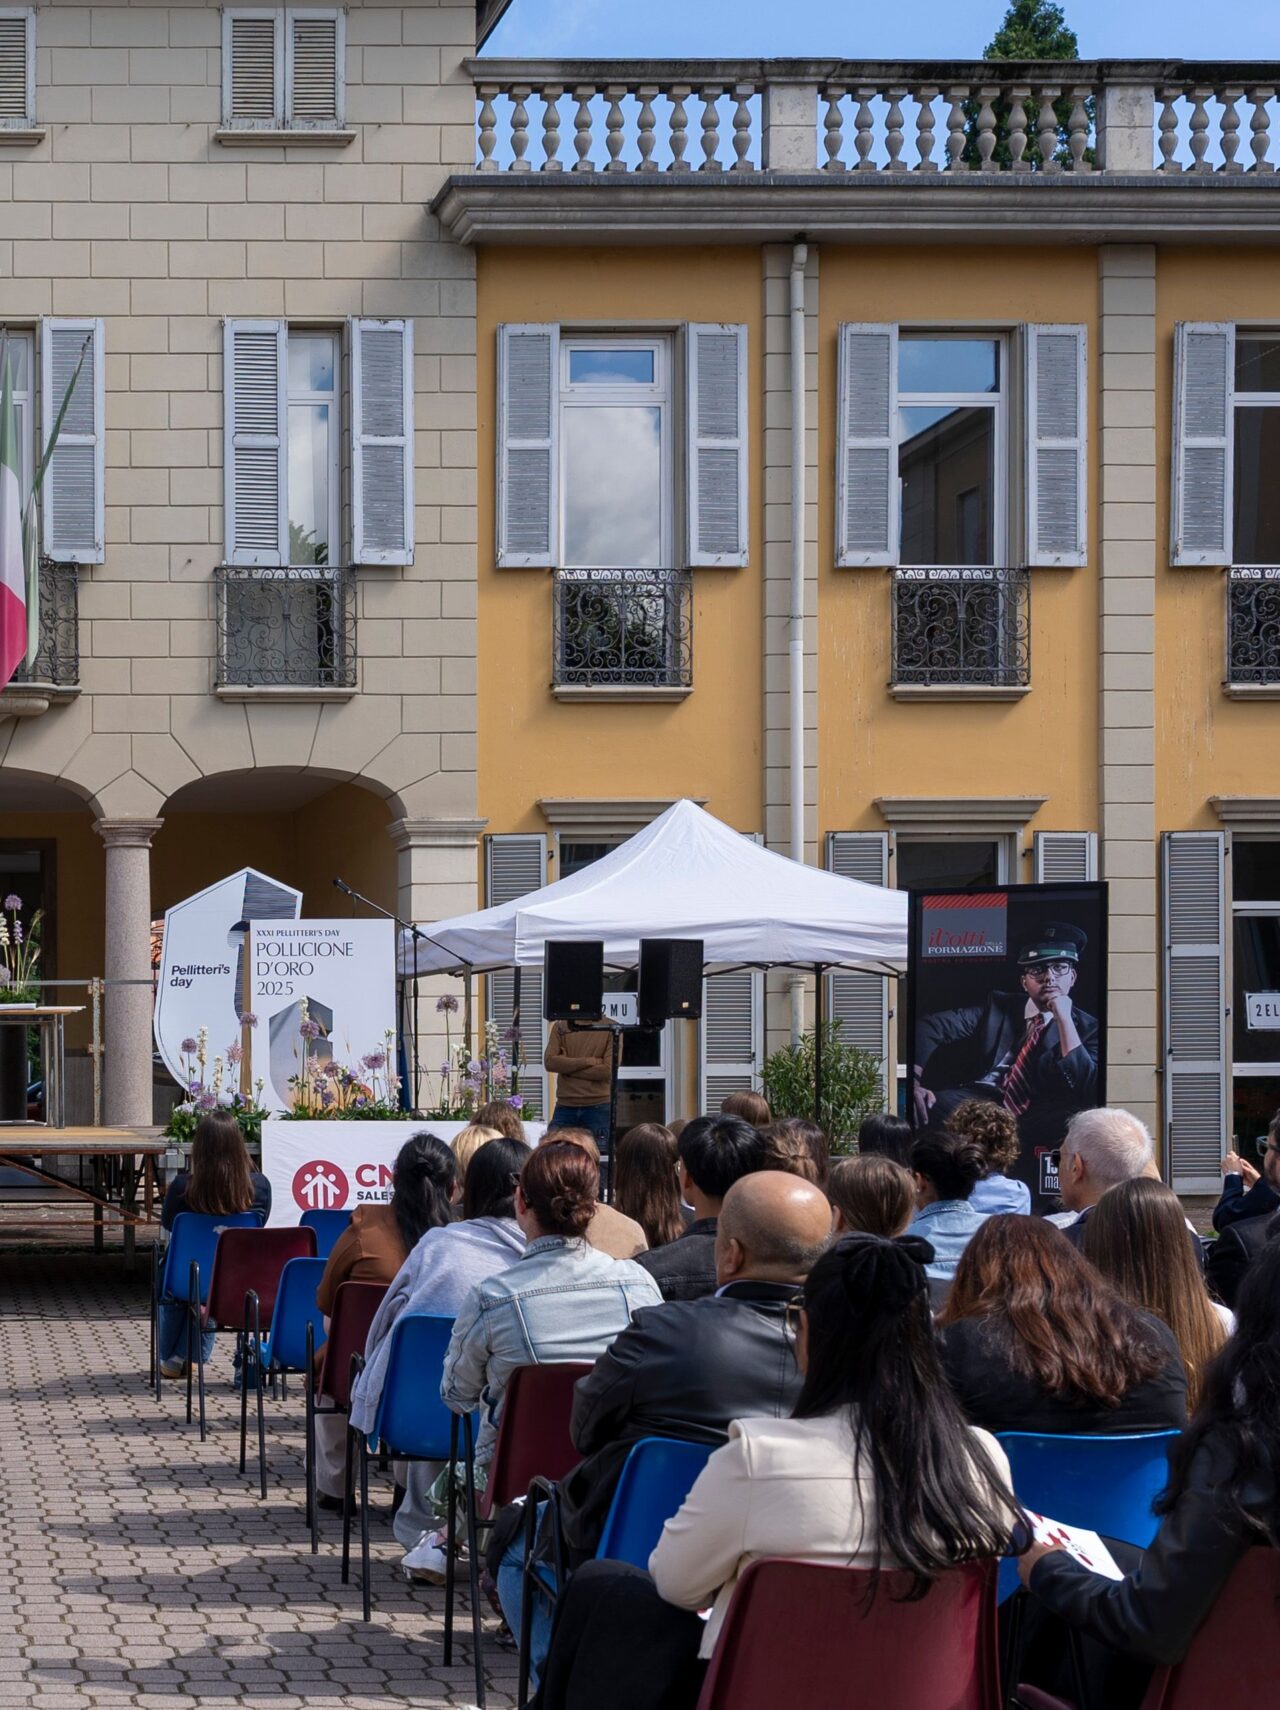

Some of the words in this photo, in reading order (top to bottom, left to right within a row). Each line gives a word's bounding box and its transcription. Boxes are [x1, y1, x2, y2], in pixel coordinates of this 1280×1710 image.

[256, 929, 274, 937] XXXI
[276, 929, 323, 937] PELLITTERI'S
[324, 929, 341, 937] DAY
[256, 941, 354, 957] POLLICIONE
[928, 945, 1004, 954] FORMAZIONE
[171, 964, 231, 976] Pellitteri's
[256, 961, 314, 976] D'ORO
[169, 976, 193, 989] day
[256, 981, 294, 996] 2025
